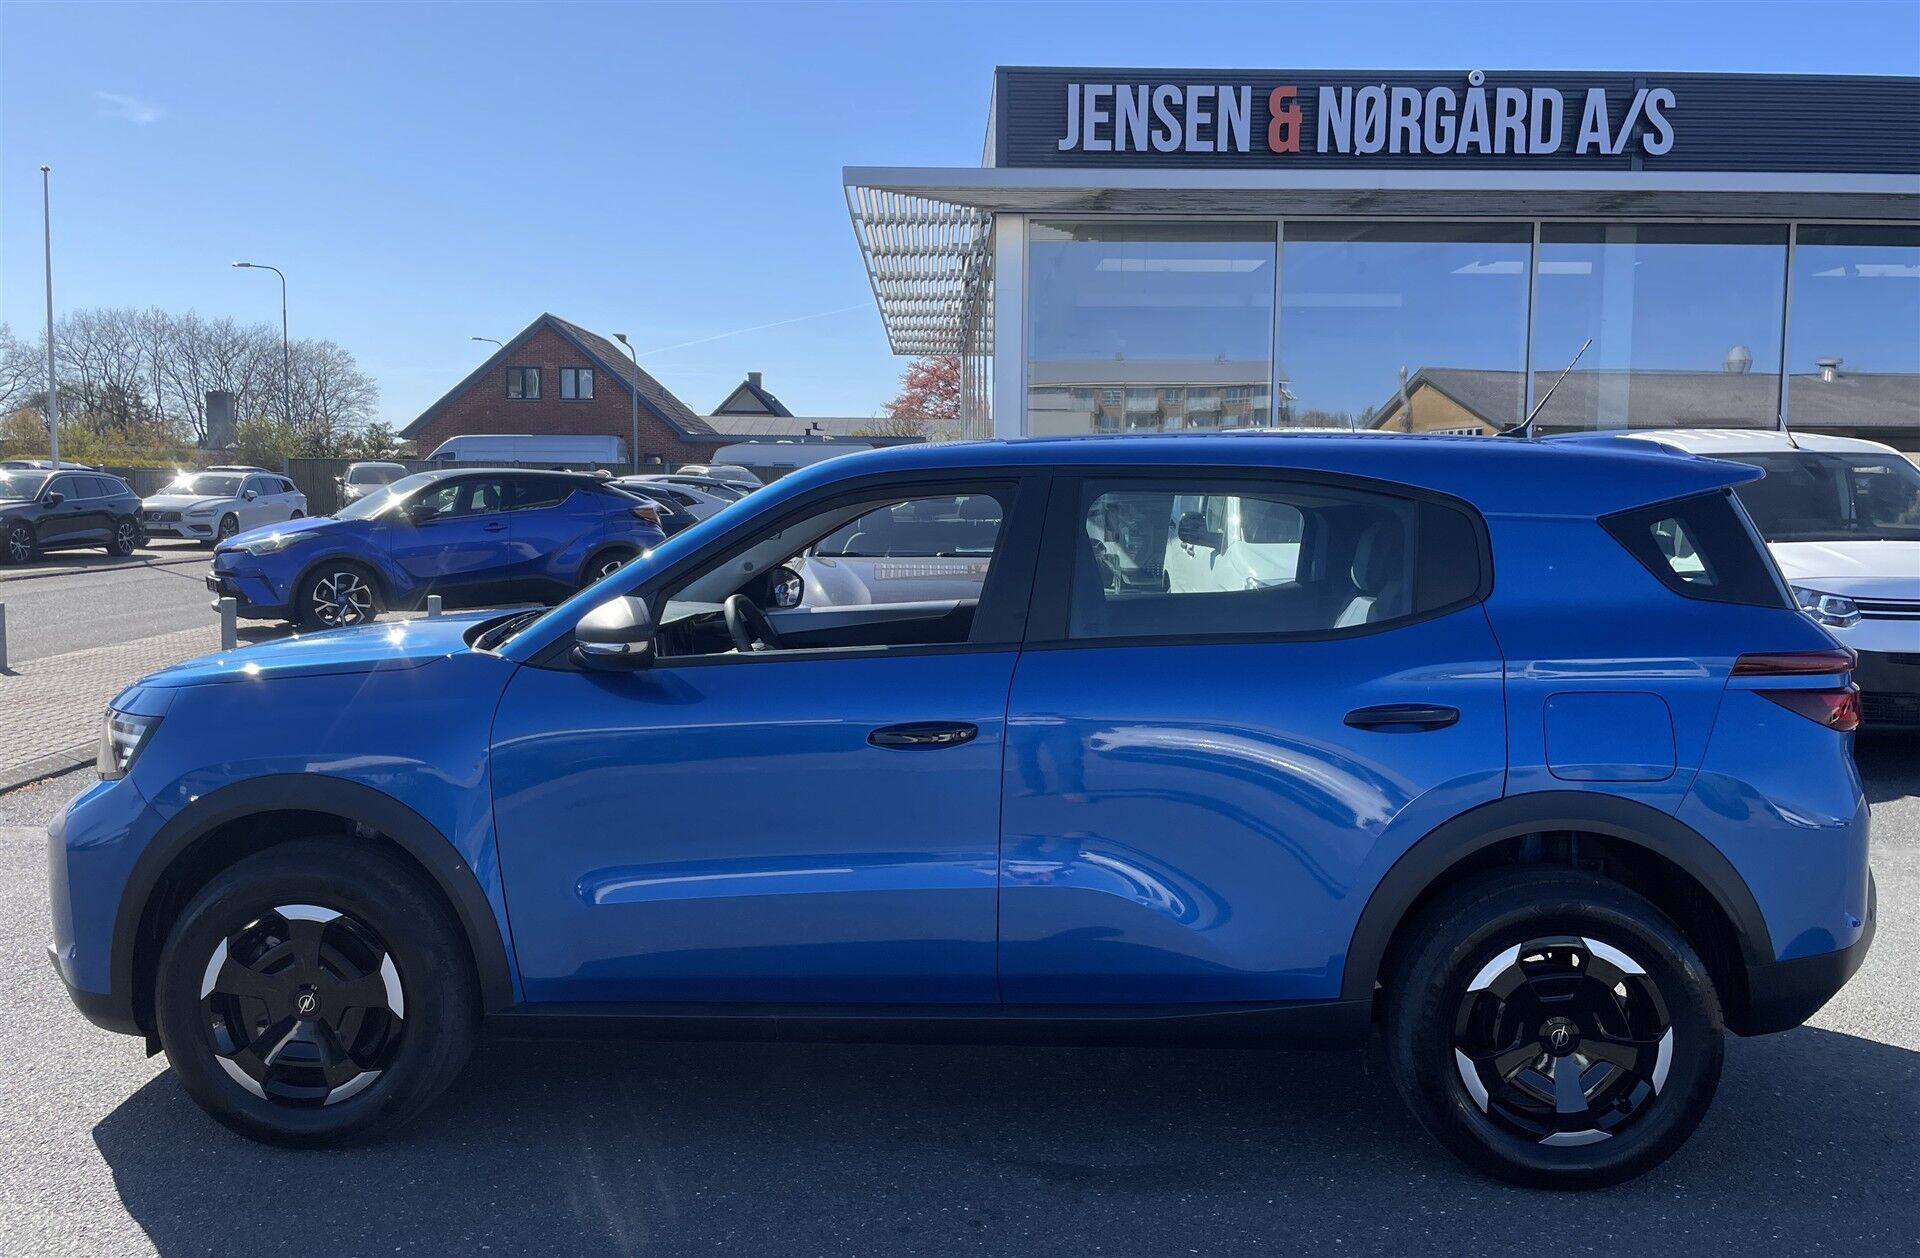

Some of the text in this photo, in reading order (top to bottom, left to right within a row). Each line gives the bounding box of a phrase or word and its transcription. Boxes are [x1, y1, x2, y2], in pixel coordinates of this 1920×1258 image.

[1058, 69, 1676, 156] JENSEN & NØRGÅRD A/S
